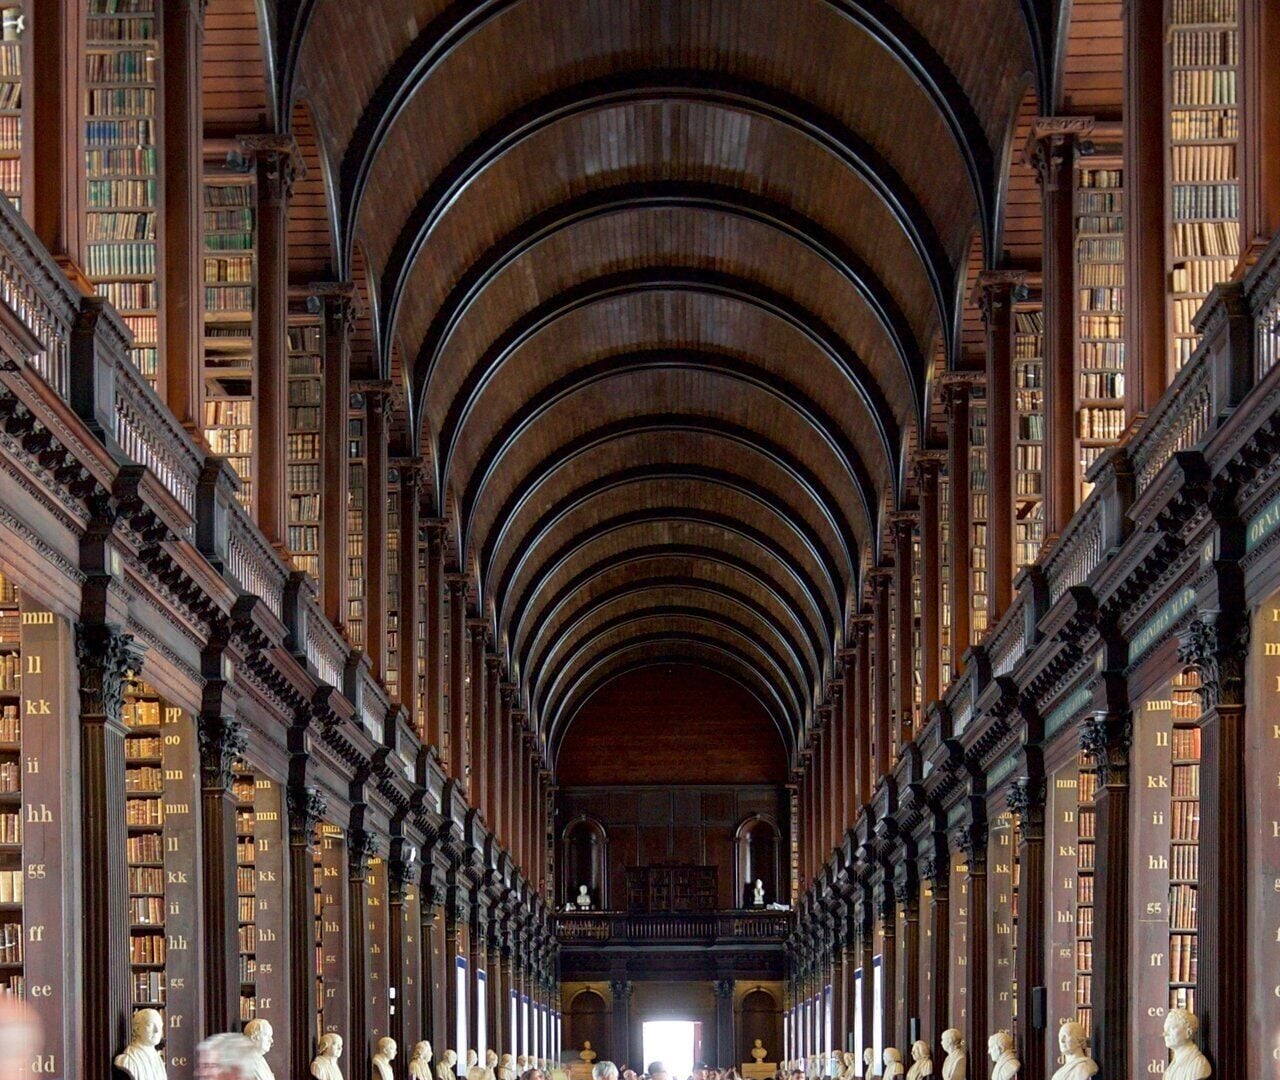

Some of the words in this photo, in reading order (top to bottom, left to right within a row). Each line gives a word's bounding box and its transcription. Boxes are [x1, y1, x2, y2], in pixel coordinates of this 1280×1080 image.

[22, 612, 53, 624] mm
[28, 656, 41, 673] ll
[26, 700, 51, 714] kk
[1147, 700, 1171, 711] mm
[165, 707, 182, 723] pp
[165, 735, 180, 745] oo
[1156, 732, 1168, 746] ll
[27, 758, 39, 773] ii
[165, 770, 183, 780] nn
[1148, 775, 1168, 788] kk
[27, 804, 53, 822] hh
[166, 804, 188, 814] mm
[1059, 846, 1076, 856] kk
[1149, 855, 1168, 870] hh
[28, 863, 46, 878] gg
[259, 871, 275, 881] kk
[168, 872, 187, 883] kk
[1147, 902, 1161, 913] gg
[1058, 911, 1074, 922] hh
[325, 922, 339, 932] hh
[997, 924, 1010, 934] hh
[29, 926, 44, 941] ff
[259, 930, 275, 942] hh
[169, 935, 187, 950] hh
[1150, 953, 1163, 966] ff
[170, 977, 184, 988] gg
[1062, 981, 1071, 991] ff
[32, 984, 52, 997] ee
[260, 998, 271, 1008] ff
[1148, 1006, 1164, 1016] ee
[170, 1015, 182, 1028] ff
[31, 1055, 55, 1073] dd
[171, 1056, 187, 1066] ee
[1148, 1059, 1165, 1073] dd
